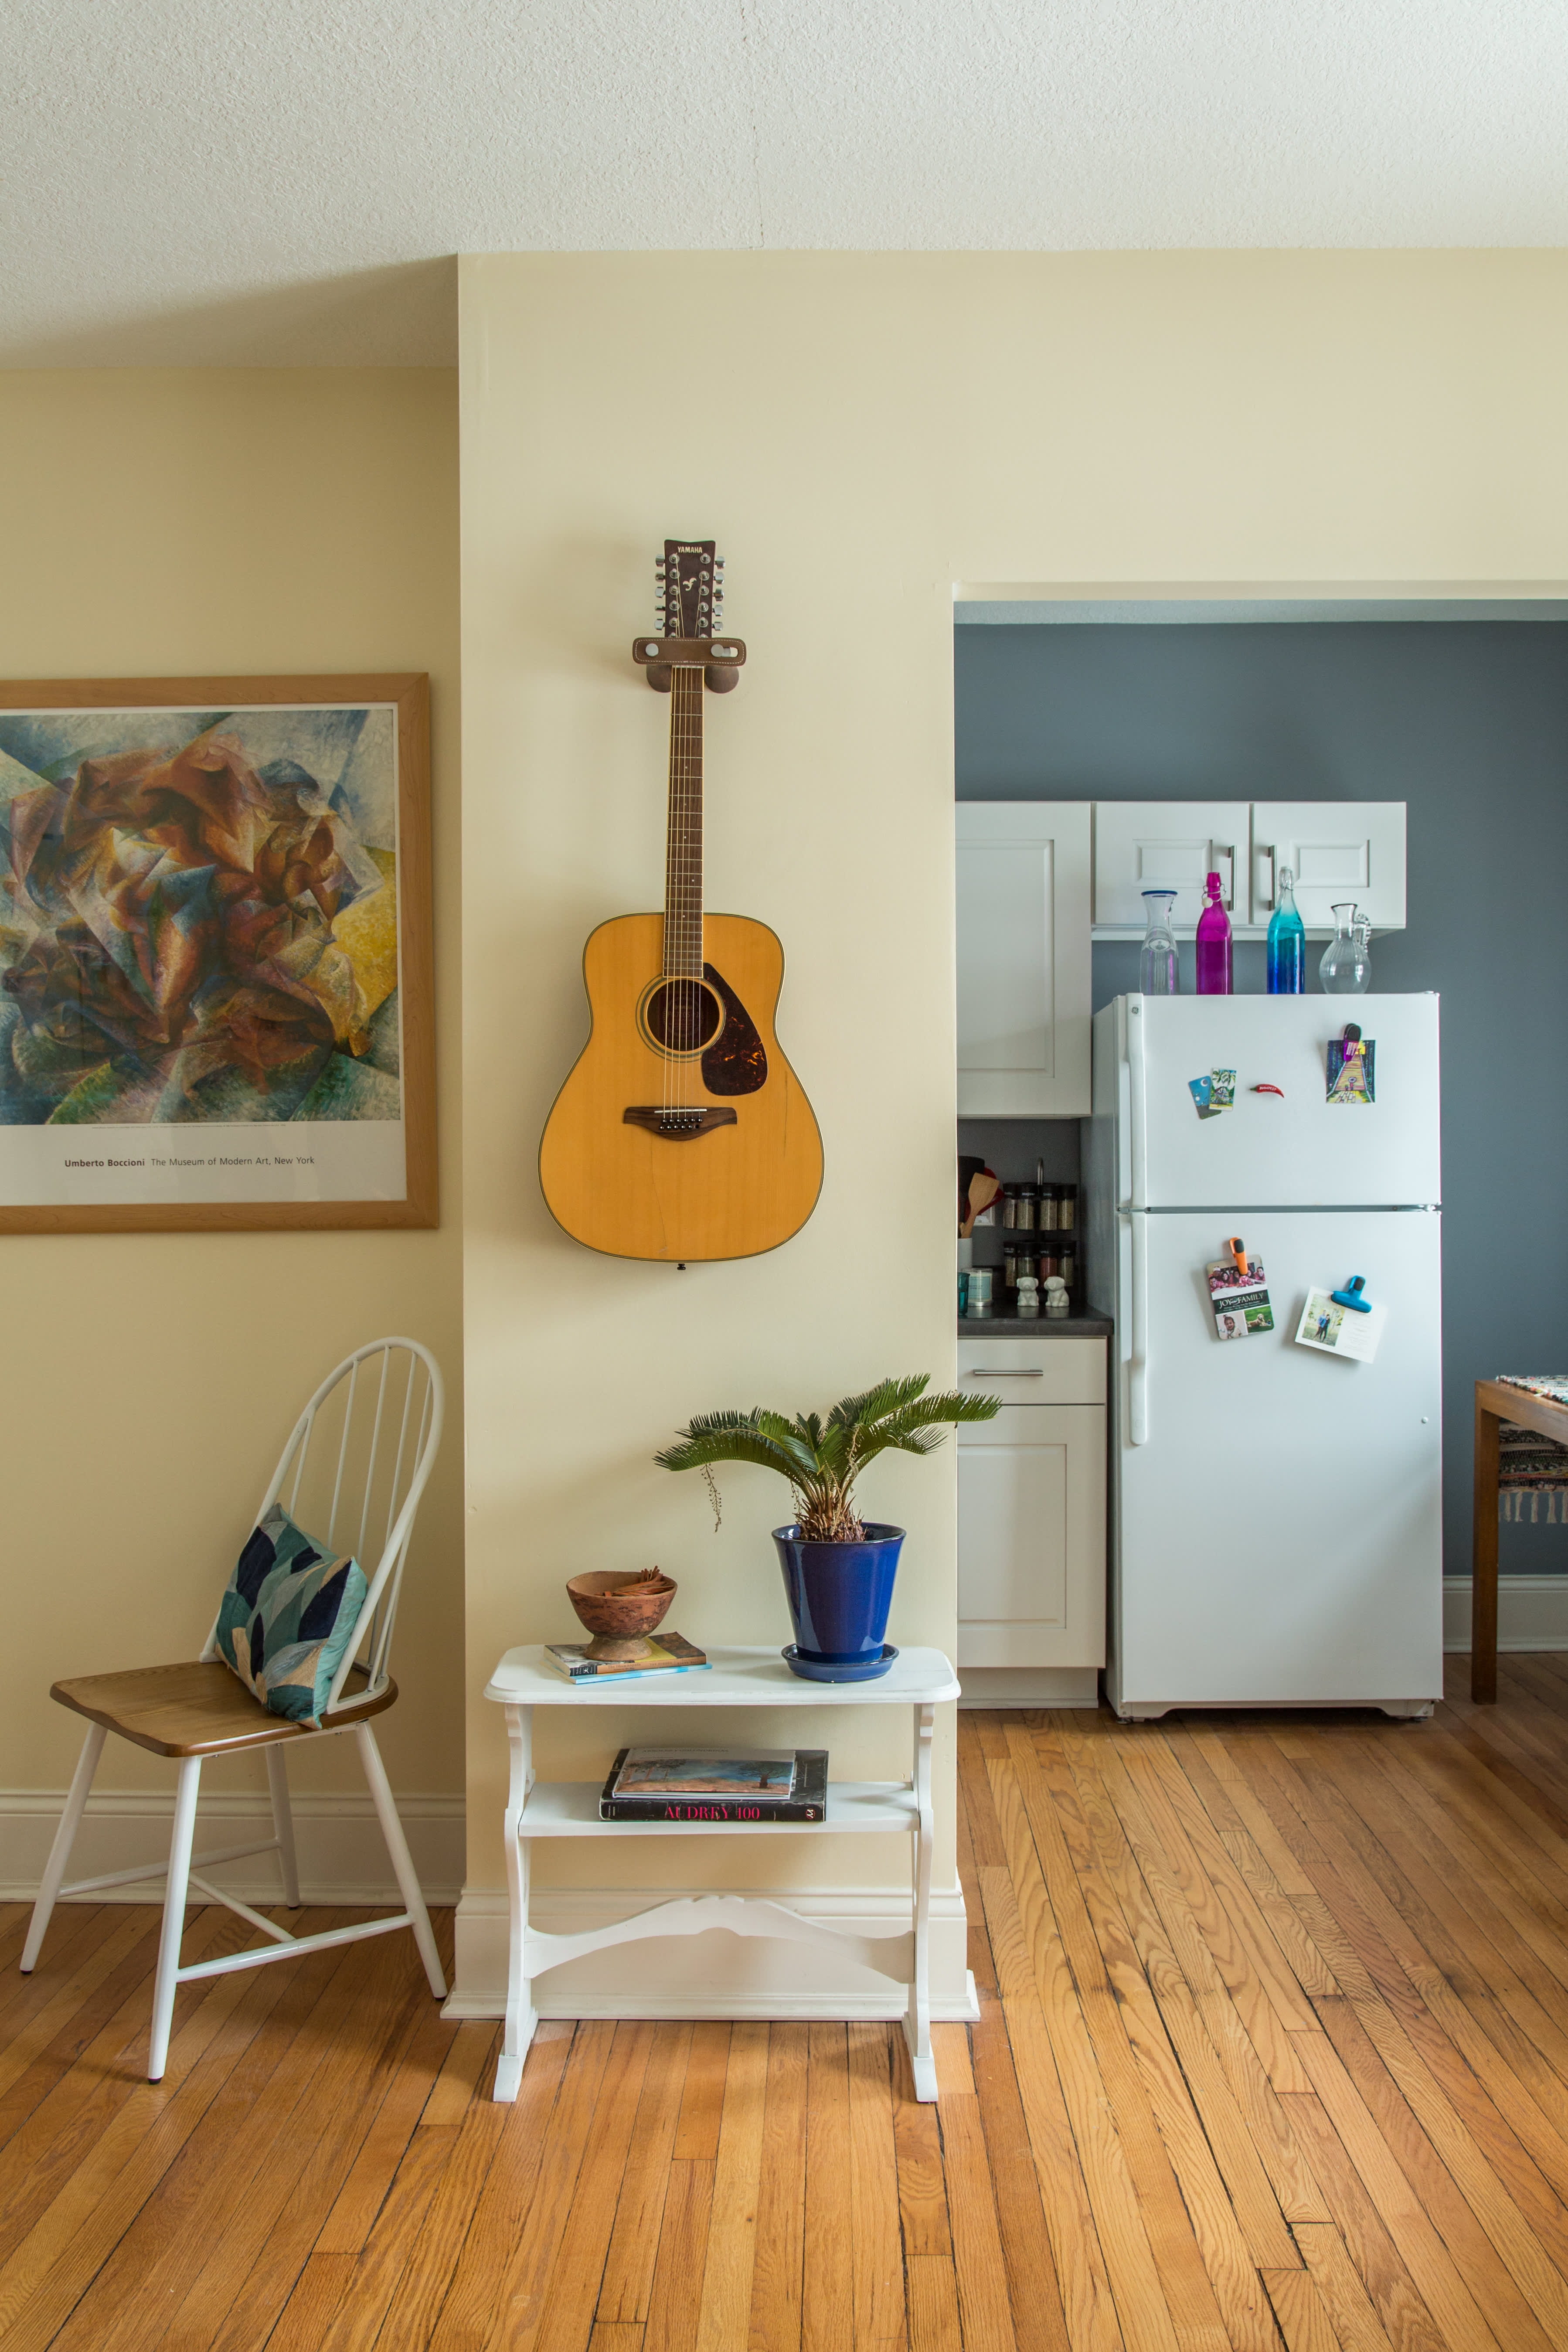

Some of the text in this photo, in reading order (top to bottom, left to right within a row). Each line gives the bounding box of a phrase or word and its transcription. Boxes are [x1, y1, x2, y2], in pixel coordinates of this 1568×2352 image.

[255, 1157, 271, 1165] Art,
[1219, 1299, 1231, 1309] JOY
[1238, 1293, 1264, 1304] FAMILY
[664, 1806, 760, 1819] AUDREY 100
